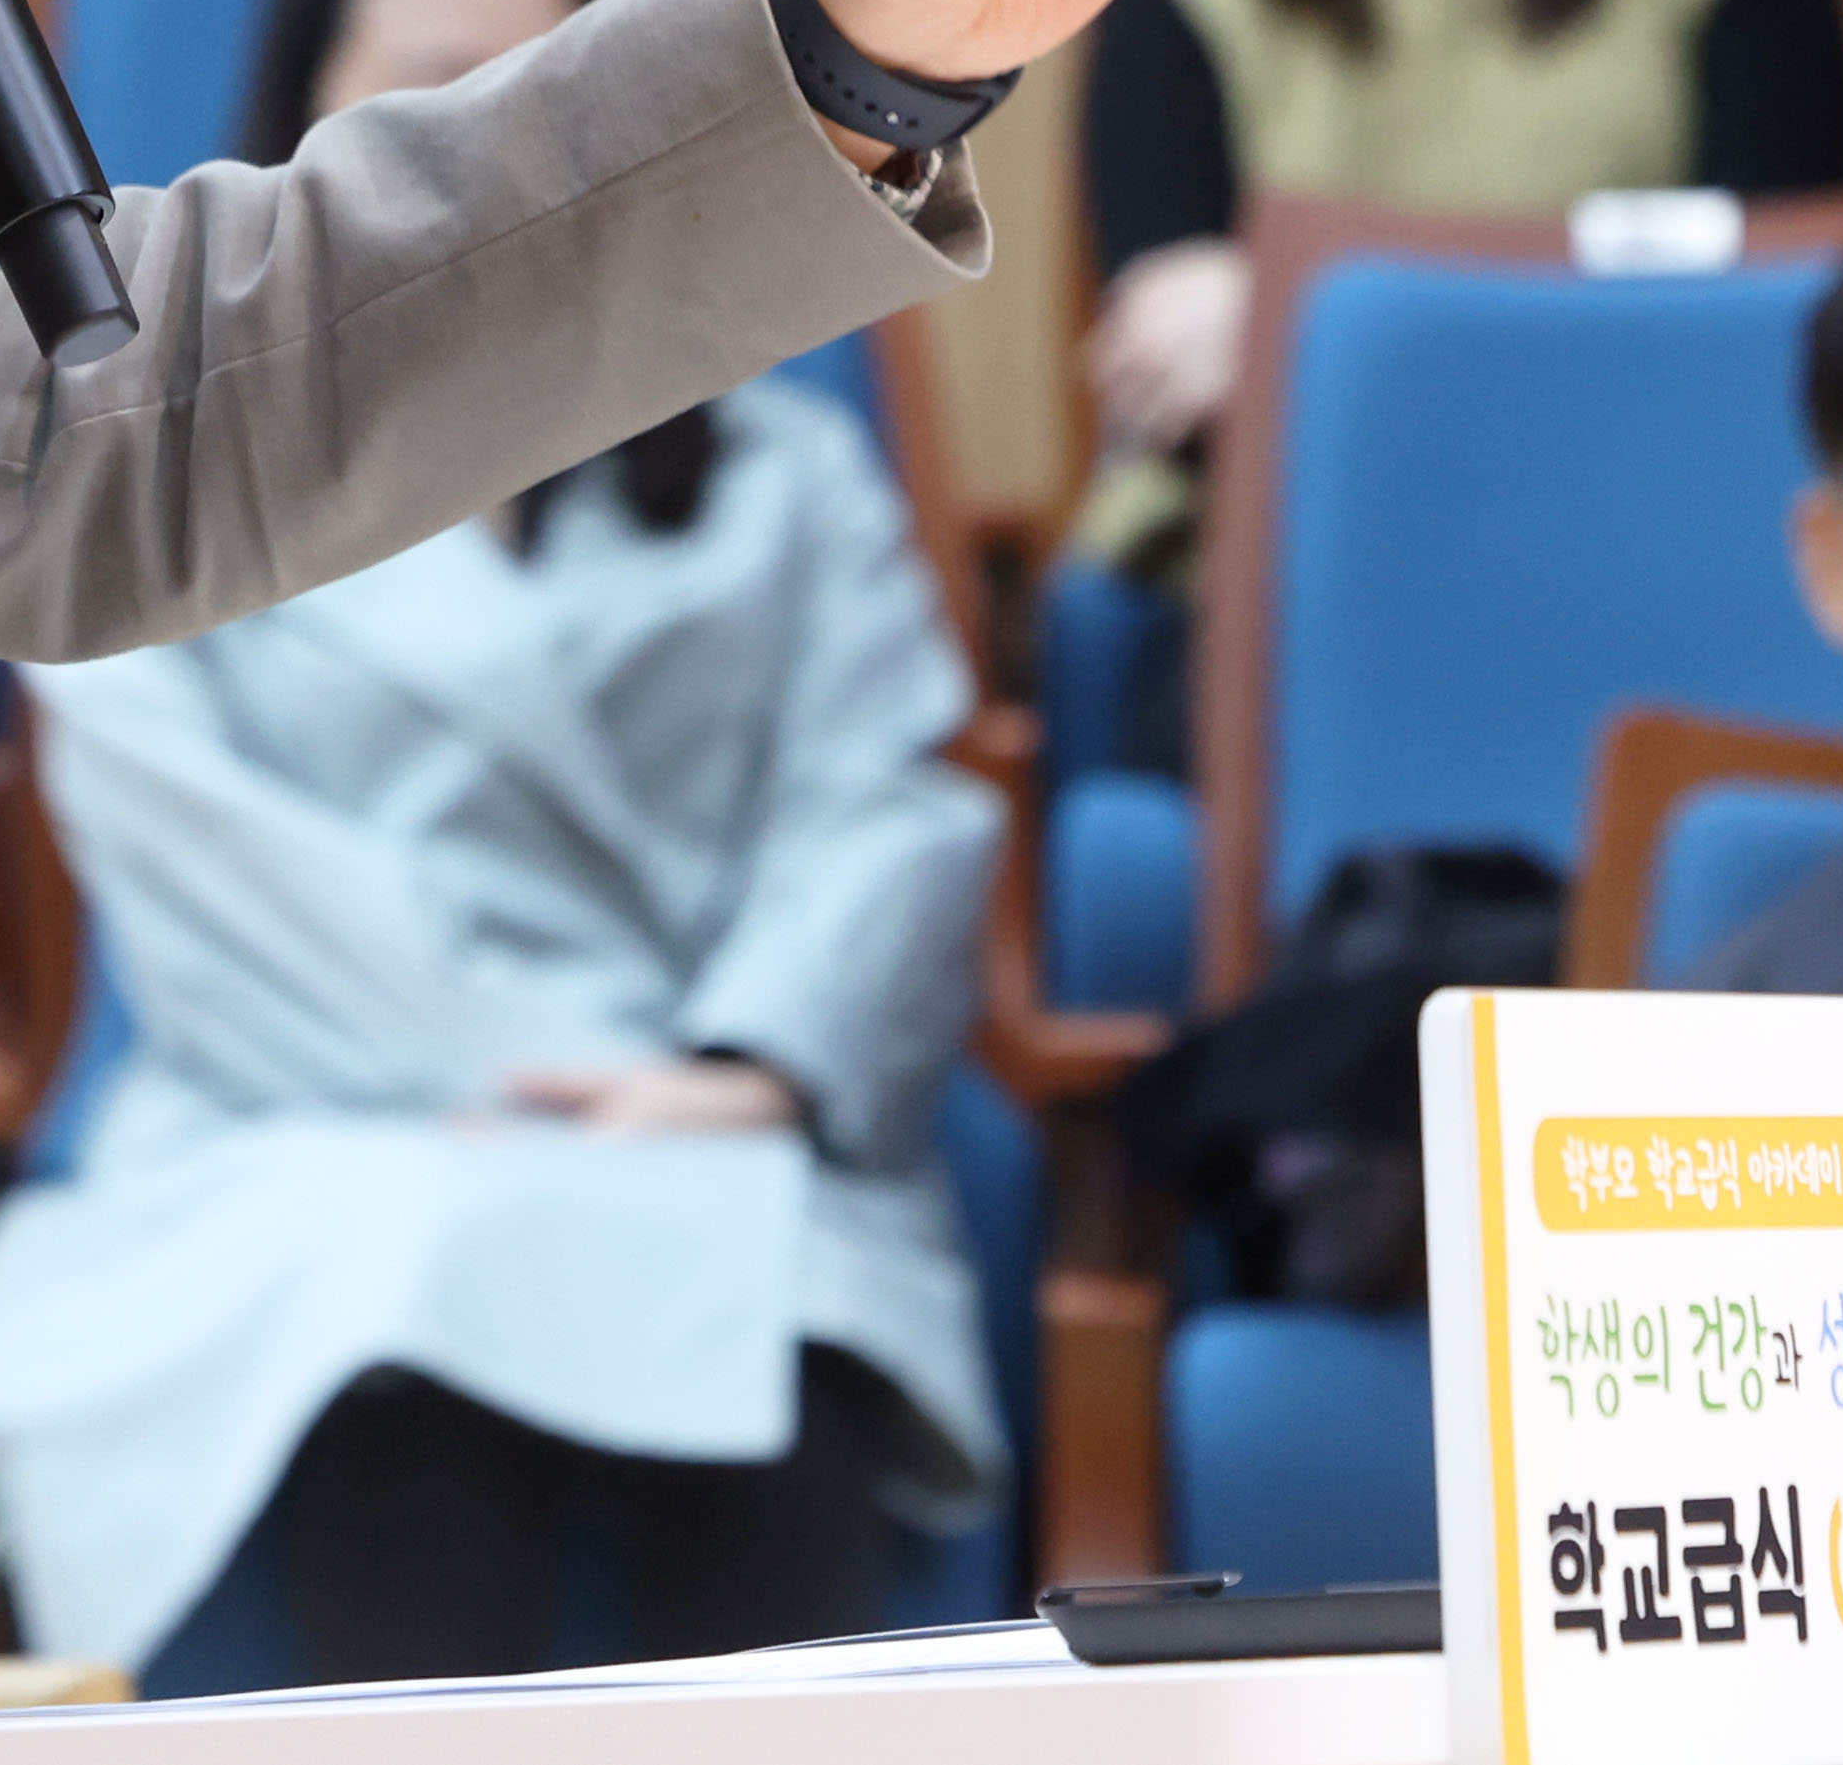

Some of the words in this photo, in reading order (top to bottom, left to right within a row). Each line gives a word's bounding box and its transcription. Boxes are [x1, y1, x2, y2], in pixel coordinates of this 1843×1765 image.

[1560, 1132, 1639, 1213] 학부모
[1645, 1131, 1741, 1211] 학교급식
[1747, 1139, 1843, 1197] 아카데미
[1536, 1292, 1670, 1420] 학생의
[1688, 1293, 1803, 1412] 건강과
[1548, 1484, 1808, 1653] 학교급식
